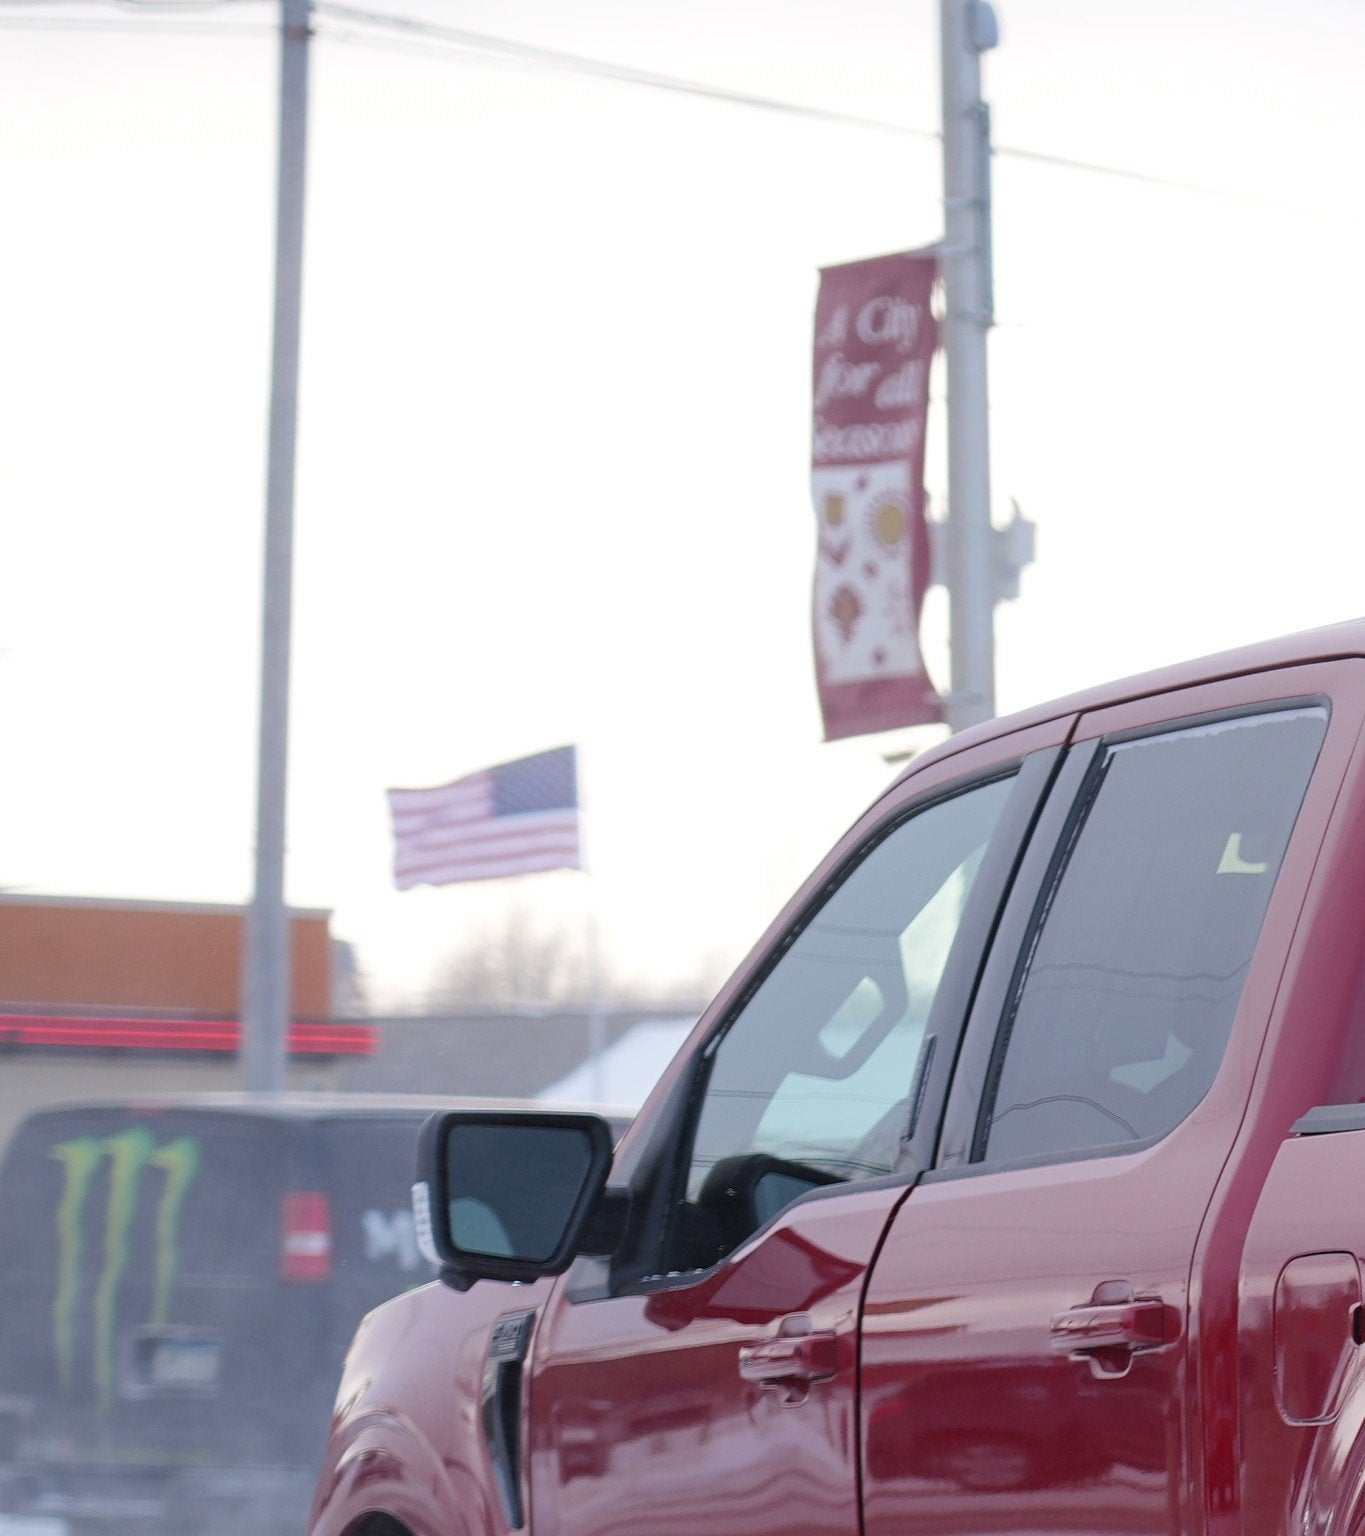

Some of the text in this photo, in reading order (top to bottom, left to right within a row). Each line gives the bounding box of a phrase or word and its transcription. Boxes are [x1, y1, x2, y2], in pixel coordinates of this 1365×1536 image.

[855, 294, 922, 353] City
[813, 351, 922, 411] for all
